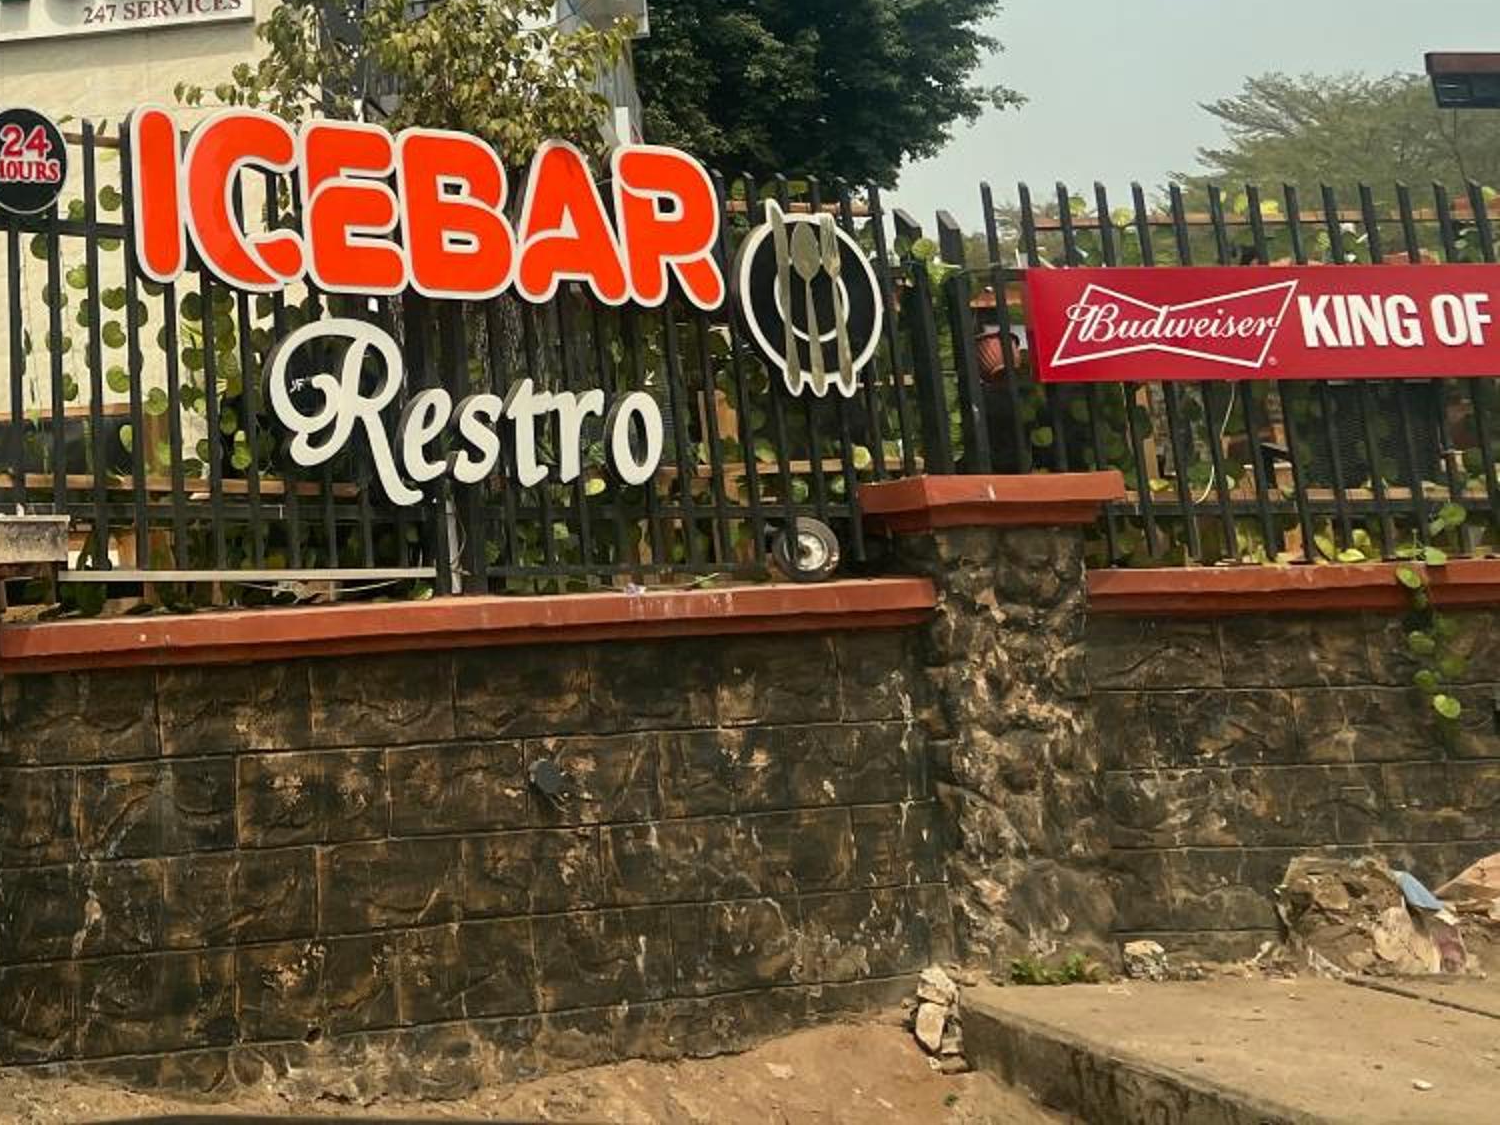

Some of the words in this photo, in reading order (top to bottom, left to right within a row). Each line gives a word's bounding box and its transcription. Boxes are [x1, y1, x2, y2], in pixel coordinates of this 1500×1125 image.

[83, 4, 117, 25] 247
[0, 123, 53, 158] 24
[127, 103, 726, 312] ICEBAR
[1066, 301, 1280, 343] Budweiser
[1298, 293, 1424, 349] KING
[1431, 293, 1492, 349] OF
[267, 317, 665, 508] Restro
